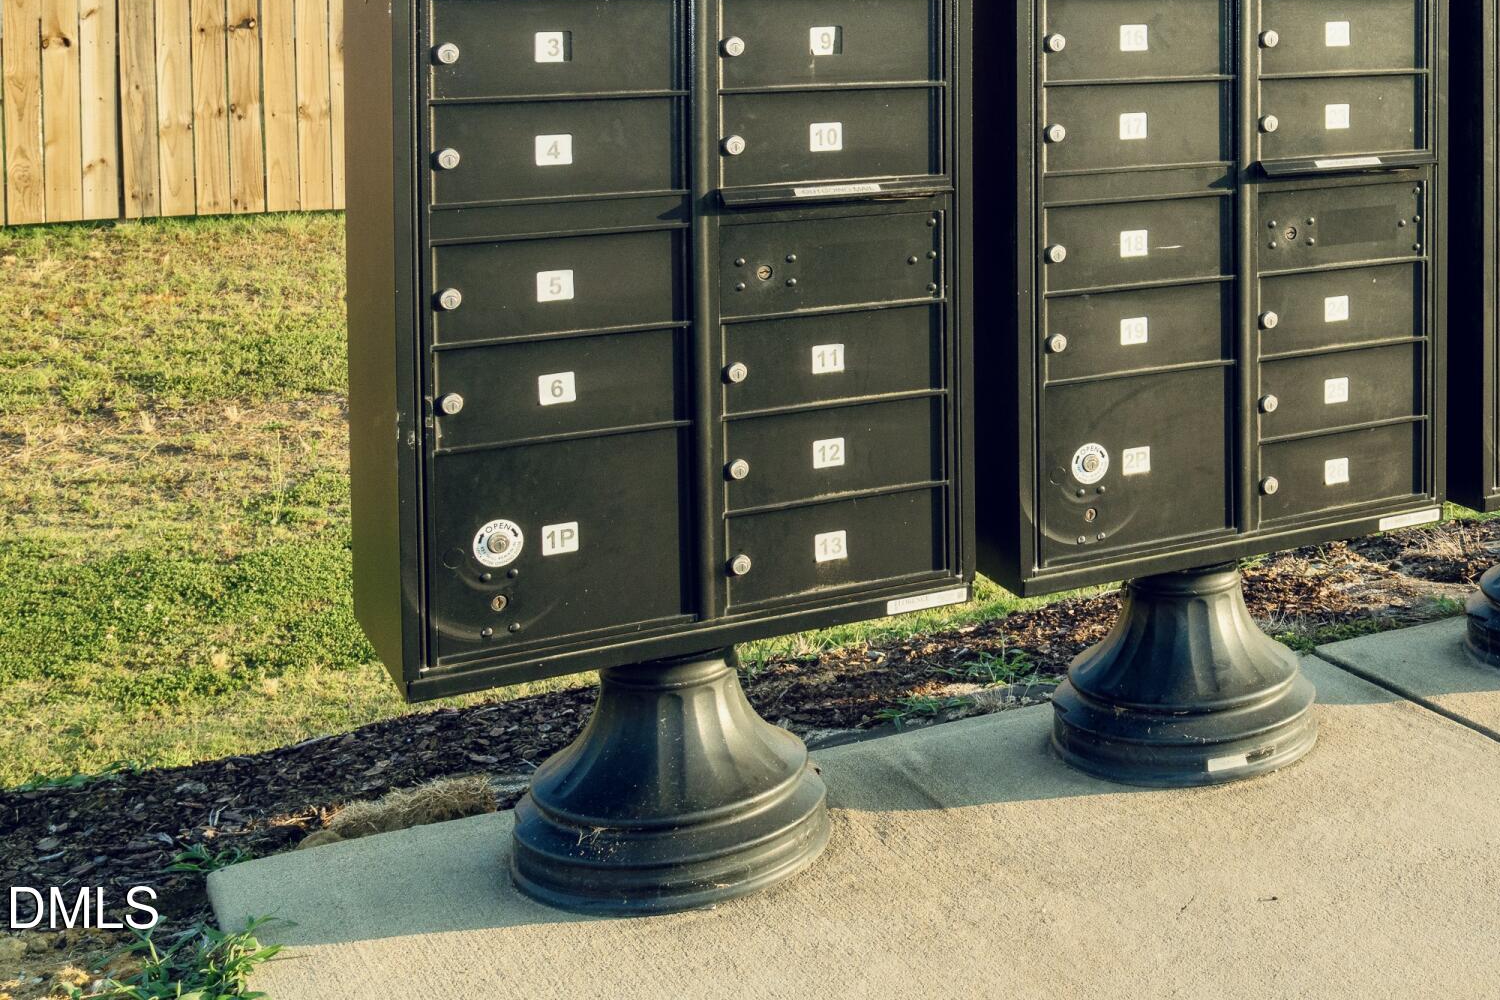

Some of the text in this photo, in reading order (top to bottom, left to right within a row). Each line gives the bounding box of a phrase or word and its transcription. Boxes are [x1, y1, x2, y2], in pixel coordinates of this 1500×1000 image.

[548, 38, 560, 57] 3
[821, 32, 832, 50] 9
[1126, 30, 1145, 47] 16
[1127, 118, 1143, 135] 17
[816, 128, 838, 147] 10
[547, 141, 561, 160] 4
[1125, 235, 1144, 252] 18
[549, 277, 562, 296] 5
[1125, 323, 1145, 340] 19
[817, 349, 838, 368] 11
[551, 379, 564, 398] 6
[1328, 383, 1346, 399] 25
[818, 444, 841, 463] 12
[1080, 445, 1100, 455] OPEN
[1125, 451, 1148, 470] 2P
[486, 523, 511, 533] OPEN
[547, 528, 575, 550] 1P
[820, 537, 842, 556] 13
